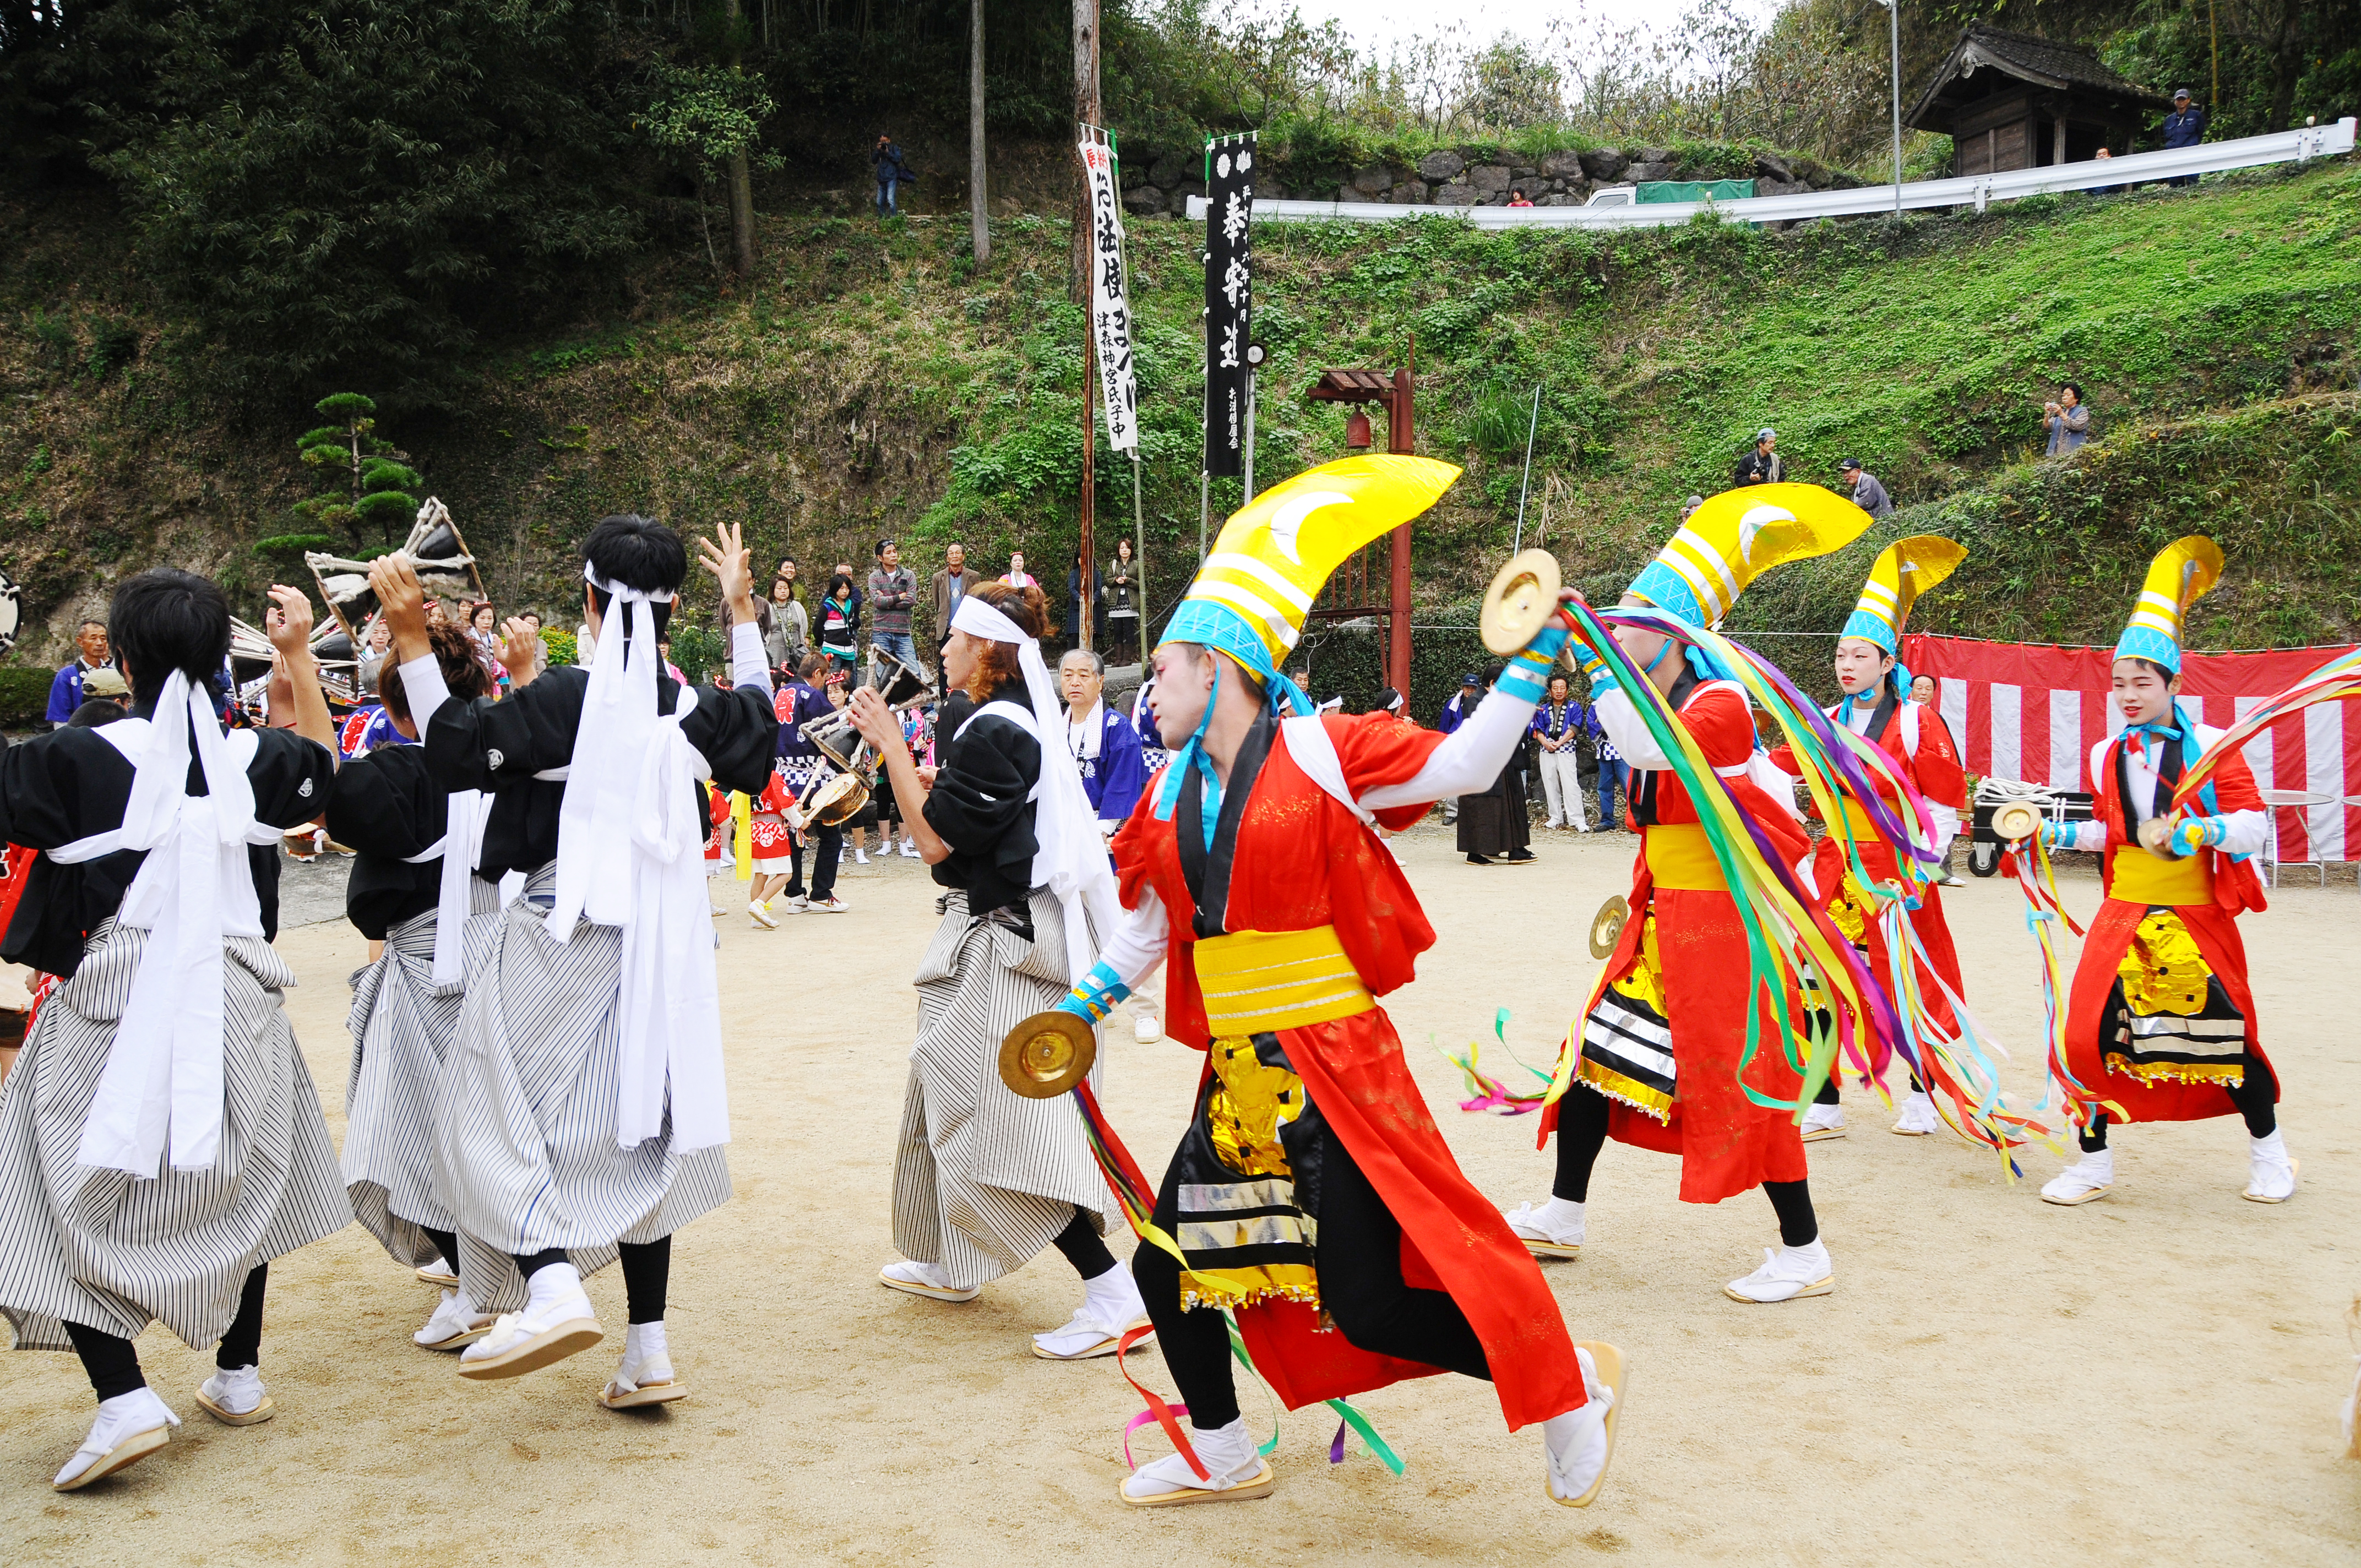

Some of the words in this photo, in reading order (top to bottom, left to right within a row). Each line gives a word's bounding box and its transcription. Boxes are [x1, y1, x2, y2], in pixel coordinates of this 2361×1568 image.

[1220, 191, 1245, 368] 奉寄進
[1239, 185, 1252, 322] 平成十六年十月
[1096, 311, 1125, 440] 津森神宮氏子中
[774, 687, 797, 725] 祭
